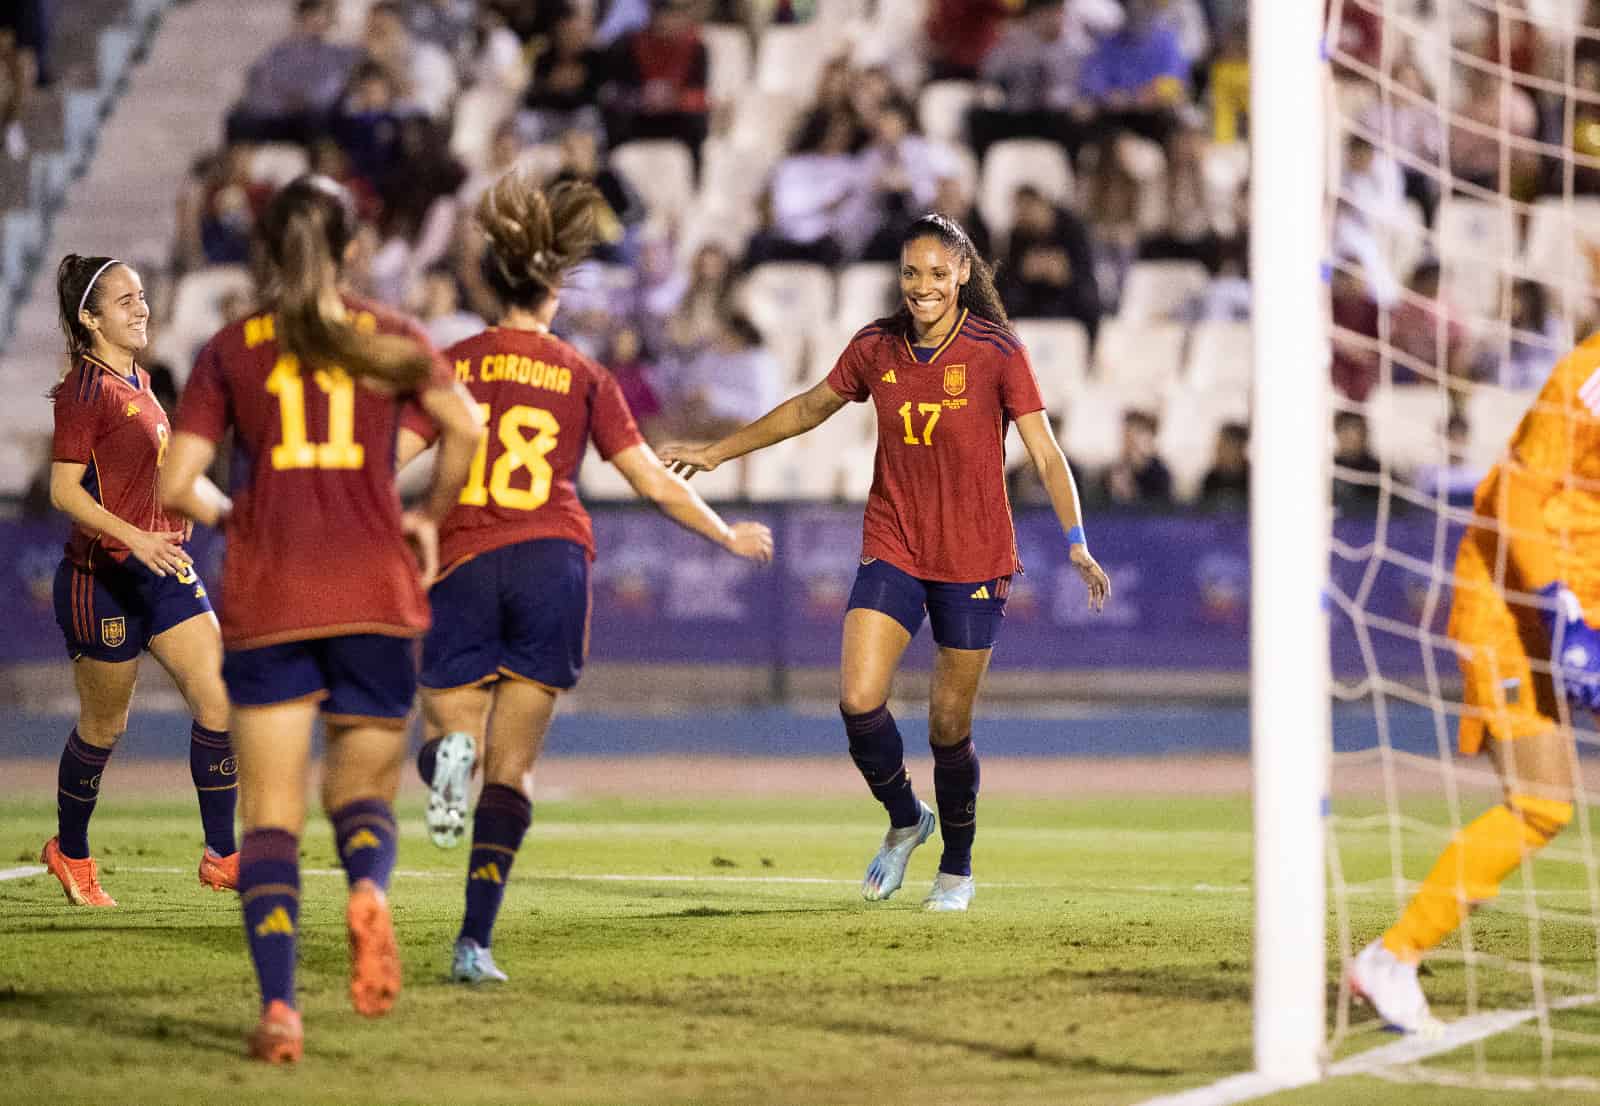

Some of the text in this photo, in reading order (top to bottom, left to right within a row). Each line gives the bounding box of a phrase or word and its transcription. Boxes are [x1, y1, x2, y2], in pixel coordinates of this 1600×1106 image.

[266, 351, 365, 471] 11
[459, 402, 560, 511] 18
[899, 401, 941, 446] 17
